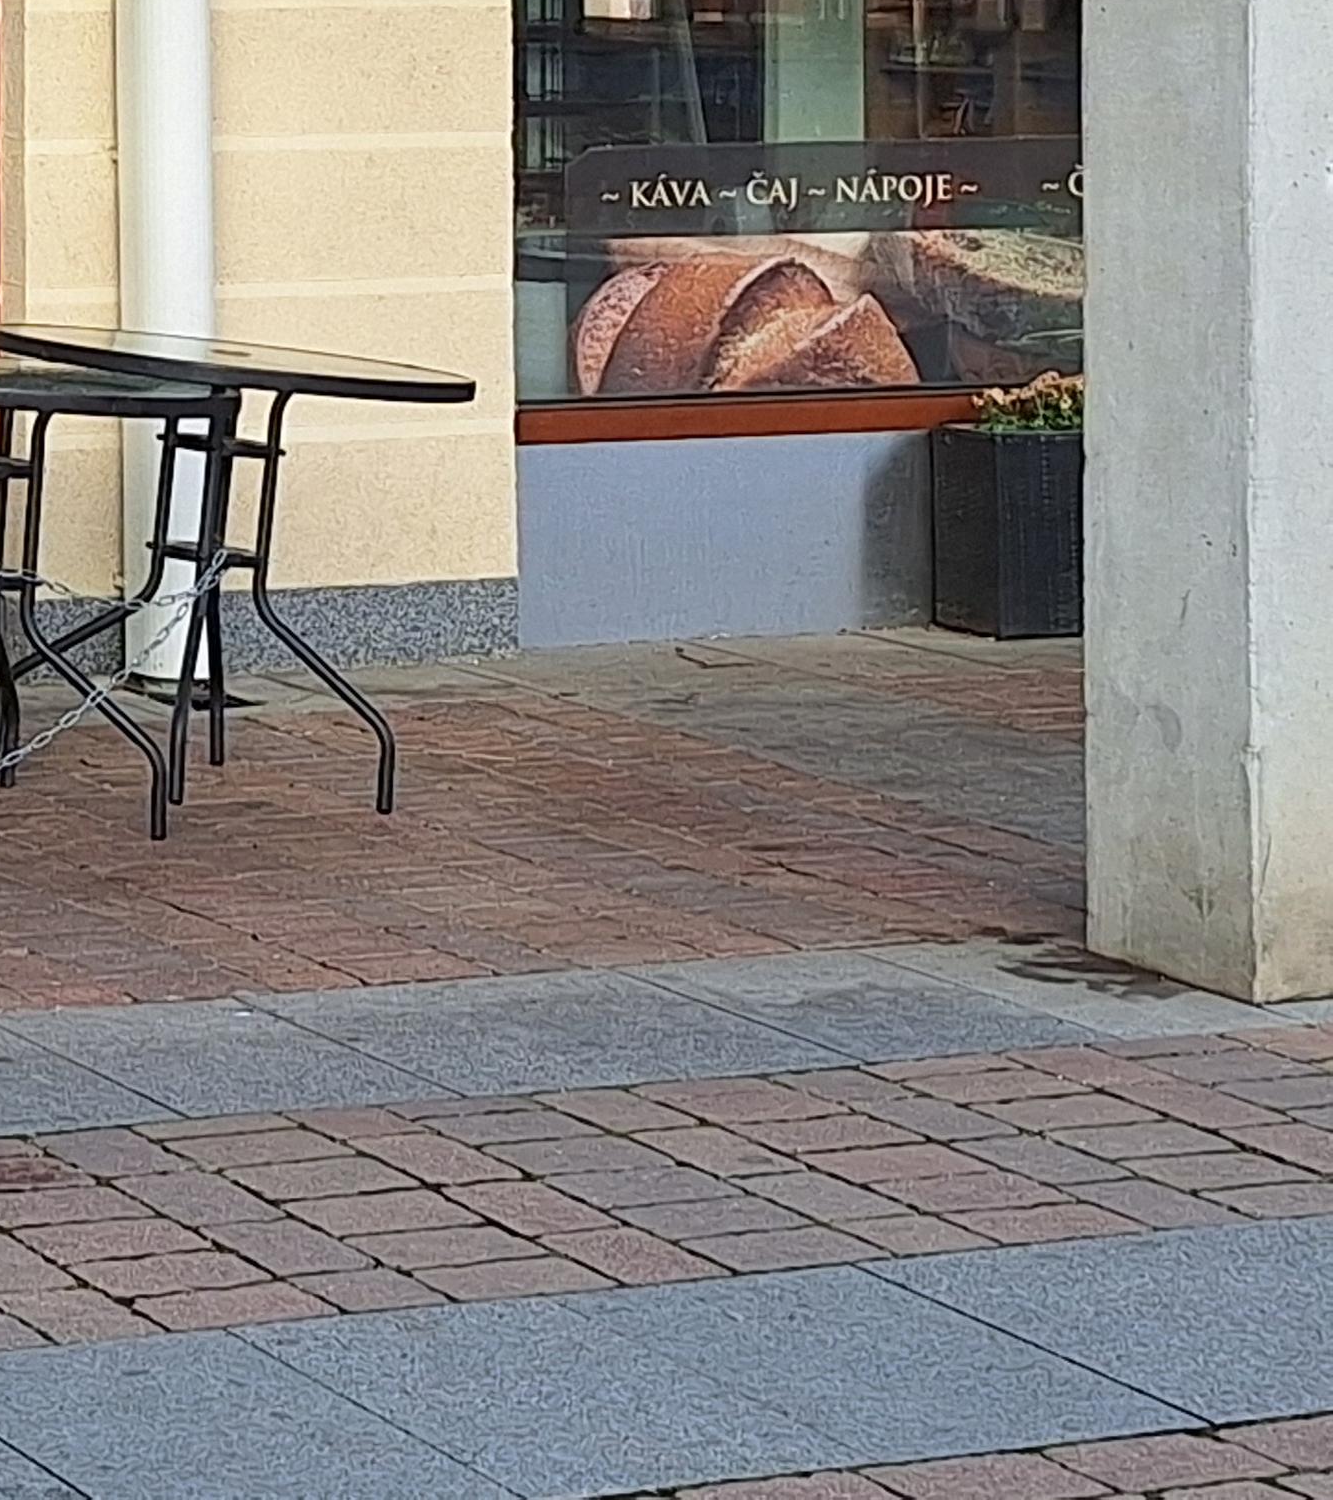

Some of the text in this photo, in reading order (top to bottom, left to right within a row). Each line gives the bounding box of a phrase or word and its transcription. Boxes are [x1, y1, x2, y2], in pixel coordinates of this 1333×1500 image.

[629, 167, 954, 211] KÁVA ČAJ NÁPOJE
